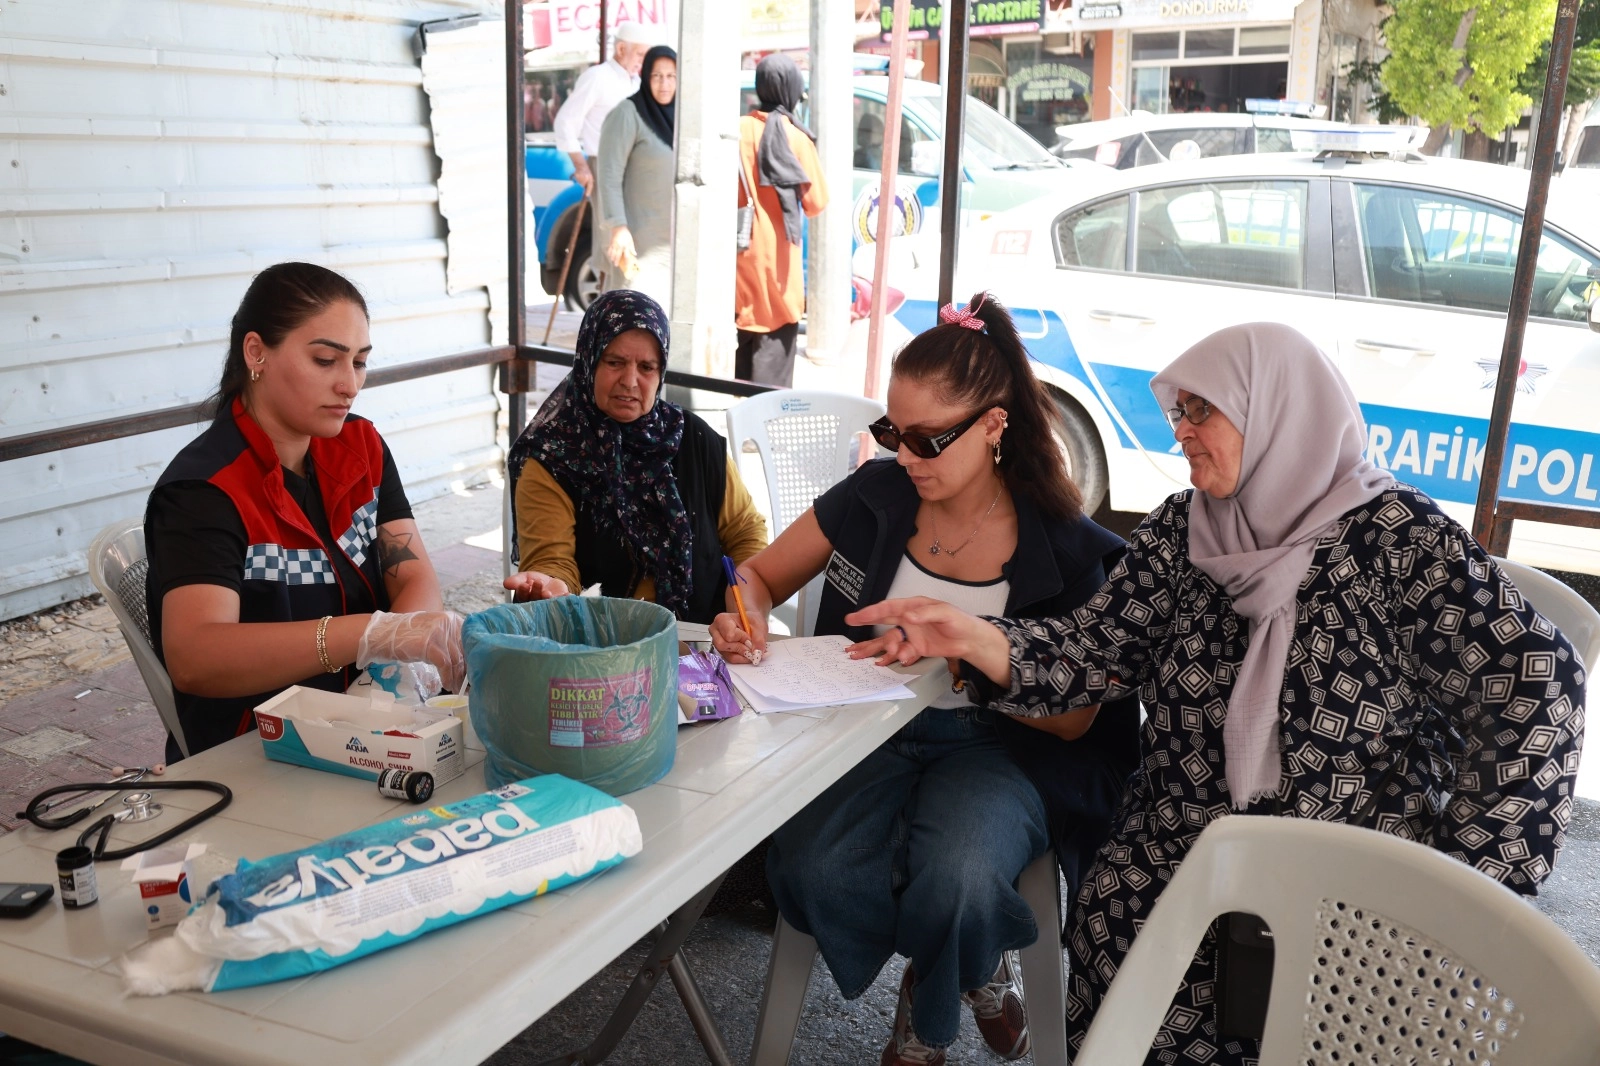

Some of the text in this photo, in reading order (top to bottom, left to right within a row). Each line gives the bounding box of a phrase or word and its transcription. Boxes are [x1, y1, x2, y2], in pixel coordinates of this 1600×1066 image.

[977, 0, 1041, 23] PASTANE
[1160, 0, 1249, 18] DONDURMA
[1365, 424, 1600, 502] RAFİK POL
[849, 569, 858, 579] VE
[551, 687, 606, 701] DİKKAT
[705, 706, 711, 714] L
[260, 722, 276, 734] 100
[345, 743, 369, 754] AQUA
[245, 801, 541, 909] papatya
